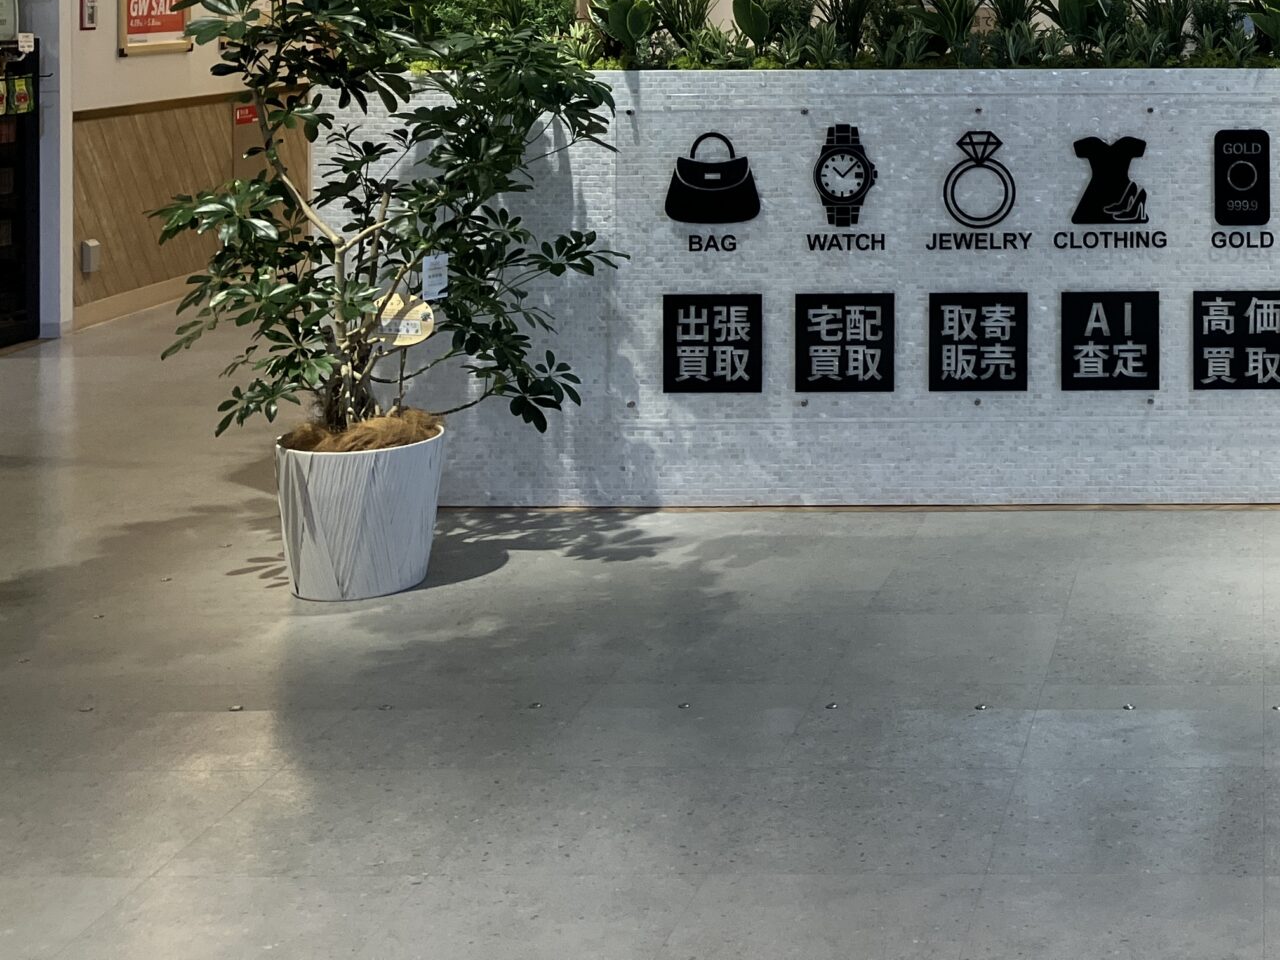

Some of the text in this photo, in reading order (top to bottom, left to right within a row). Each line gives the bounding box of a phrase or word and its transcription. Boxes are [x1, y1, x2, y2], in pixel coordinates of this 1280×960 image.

[1222, 142, 1262, 155] GOLD
[1226, 200, 1258, 211] 999.9
[688, 234, 738, 252] BAG
[806, 233, 886, 251] WATCH
[925, 232, 1033, 250] JEWELRY
[1053, 231, 1168, 249] CLOTHING
[1211, 231, 1274, 249] GOLD
[676, 305, 750, 342] 出張
[807, 304, 882, 341] 宅配
[940, 304, 1017, 341] 取寄
[1084, 302, 1132, 337] AI
[675, 345, 750, 382] 買取
[808, 344, 883, 382] 買取
[941, 344, 1017, 381] 販売
[1073, 340, 1148, 378] 査定
